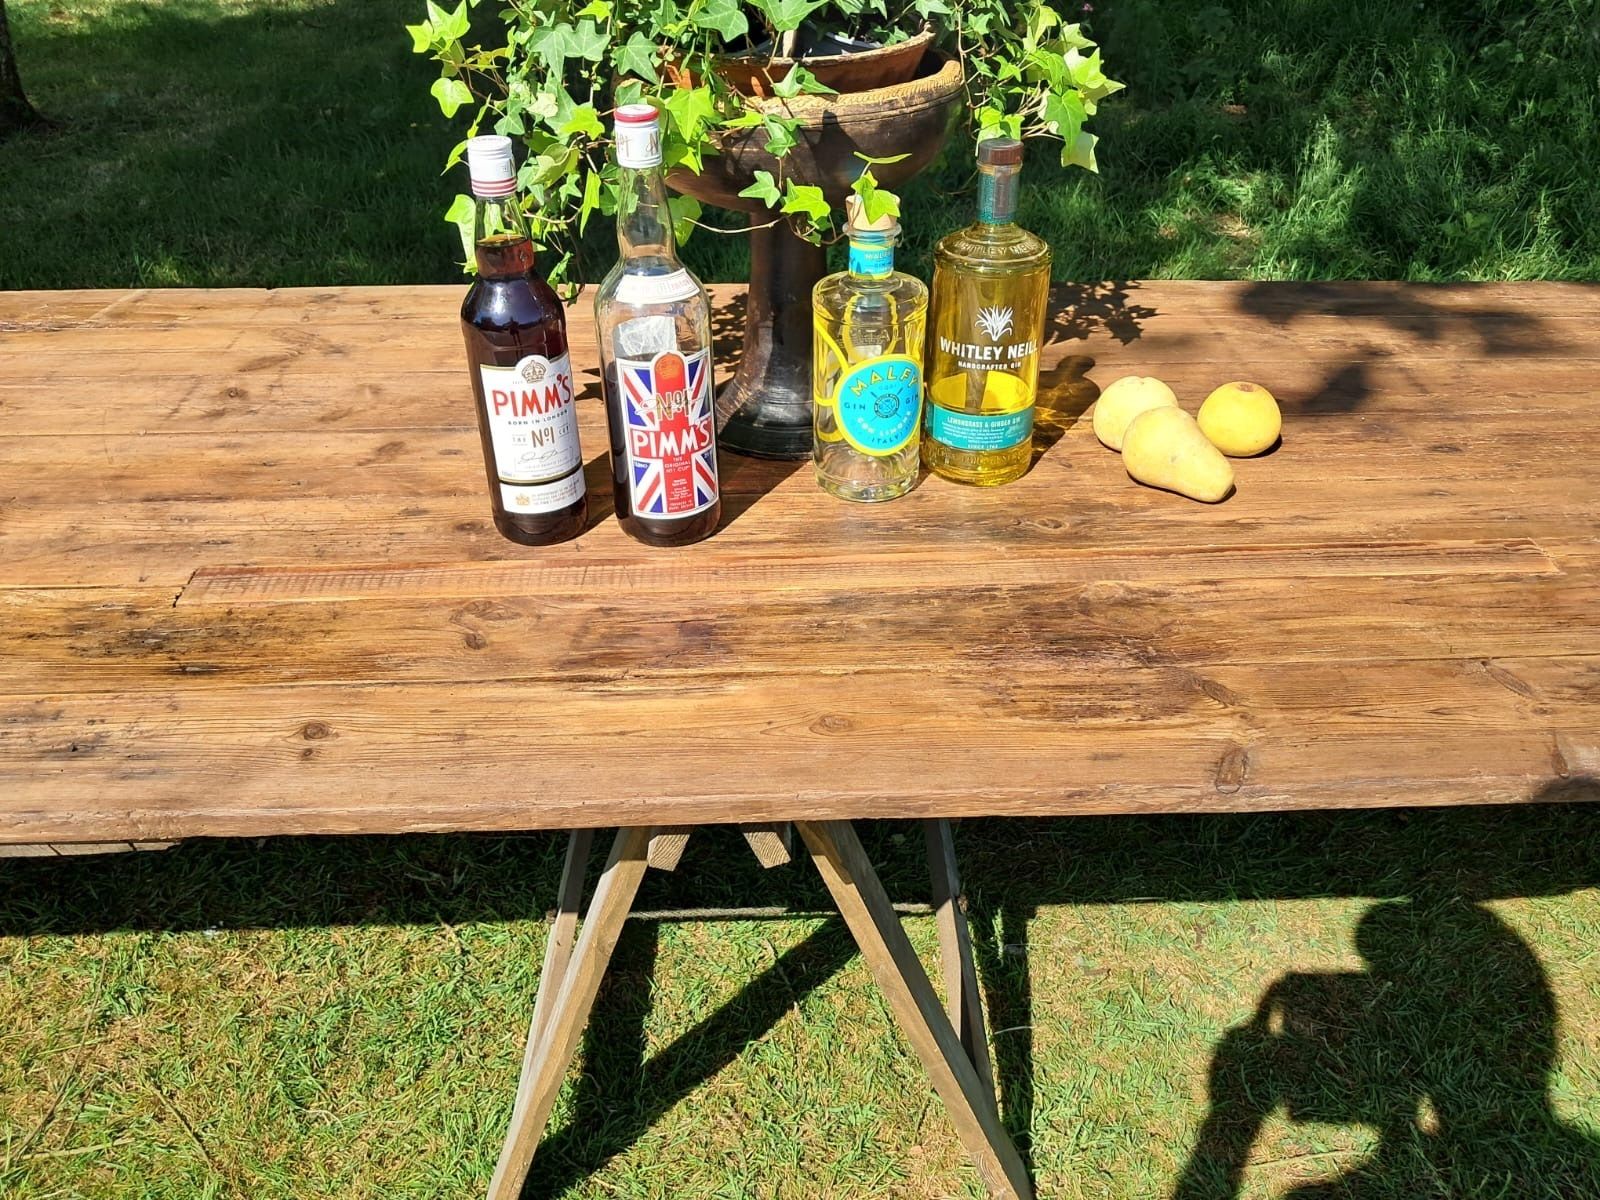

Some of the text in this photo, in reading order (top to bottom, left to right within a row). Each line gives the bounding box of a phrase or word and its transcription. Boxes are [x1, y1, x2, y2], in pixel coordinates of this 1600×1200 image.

[940, 336, 1038, 361] WHITLEY NEILL
[958, 360, 1022, 370] HANDCRAFTED GIN
[491, 373, 571, 417] PIMM'S
[849, 365, 919, 397] MALFY
[844, 402, 866, 410] GIN
[632, 420, 710, 457] PIMM'S
